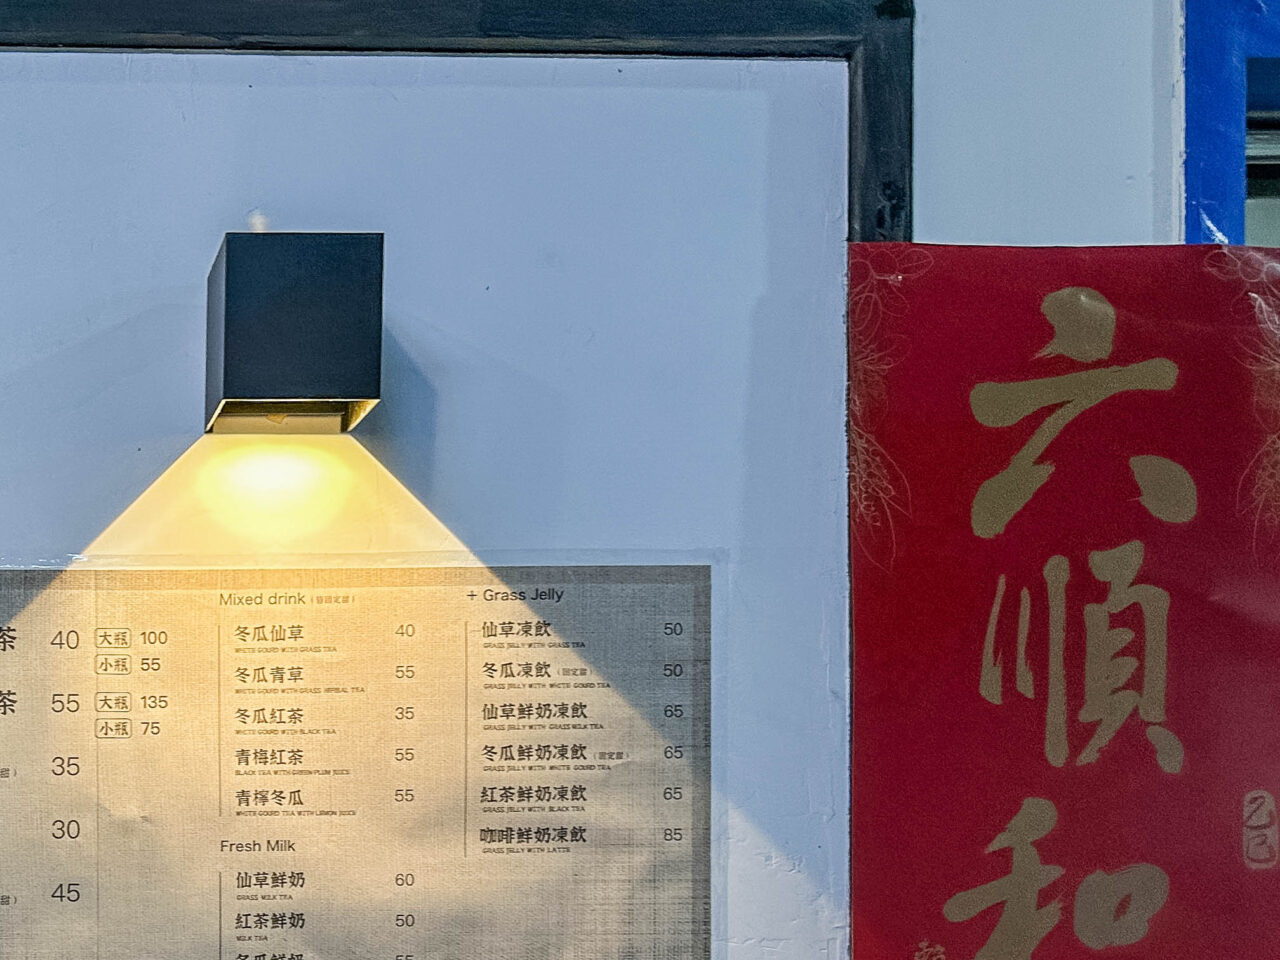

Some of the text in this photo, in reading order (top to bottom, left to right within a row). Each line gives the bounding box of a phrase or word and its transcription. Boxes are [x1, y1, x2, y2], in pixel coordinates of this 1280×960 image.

[220, 593, 263, 605] Mixed
[268, 593, 305, 605] drink
[483, 589, 526, 601] Grass
[531, 588, 564, 603] Jelly
[234, 624, 415, 642] 冬瓜仙草 40
[482, 621, 683, 637] 仙草凍飲 50
[51, 630, 80, 649] 40
[99, 631, 168, 645] 大瓶 100
[99, 658, 161, 672] 小瓶 55
[483, 662, 551, 678] 冬瓜凍飲
[663, 664, 683, 677] 50
[235, 666, 415, 683] 冬瓜青草 55
[51, 694, 80, 713] 55
[99, 696, 168, 710] 大瓶 135
[482, 703, 683, 720] 仙草鮮奶凍飲 65
[235, 707, 414, 724] 冬瓜紅茶 35
[99, 722, 160, 736] 小瓶 75
[235, 748, 414, 765] 青梅紅茶 55
[481, 744, 586, 761] 冬瓜鮮奶凍飲
[664, 746, 683, 759] 65
[51, 756, 80, 776] 35
[236, 789, 414, 806] 青檸冬瓜 55
[480, 785, 682, 802] 紅茶鮮奶凍飲 65
[51, 820, 80, 839] 30
[480, 826, 682, 843] 咖啡鮮奶凍飲 85
[221, 840, 295, 852] Fresh Milk
[236, 871, 415, 889] 仙草鮮奶 60
[51, 883, 80, 902] 45
[235, 912, 415, 929] 紅茶鮮奶 50
